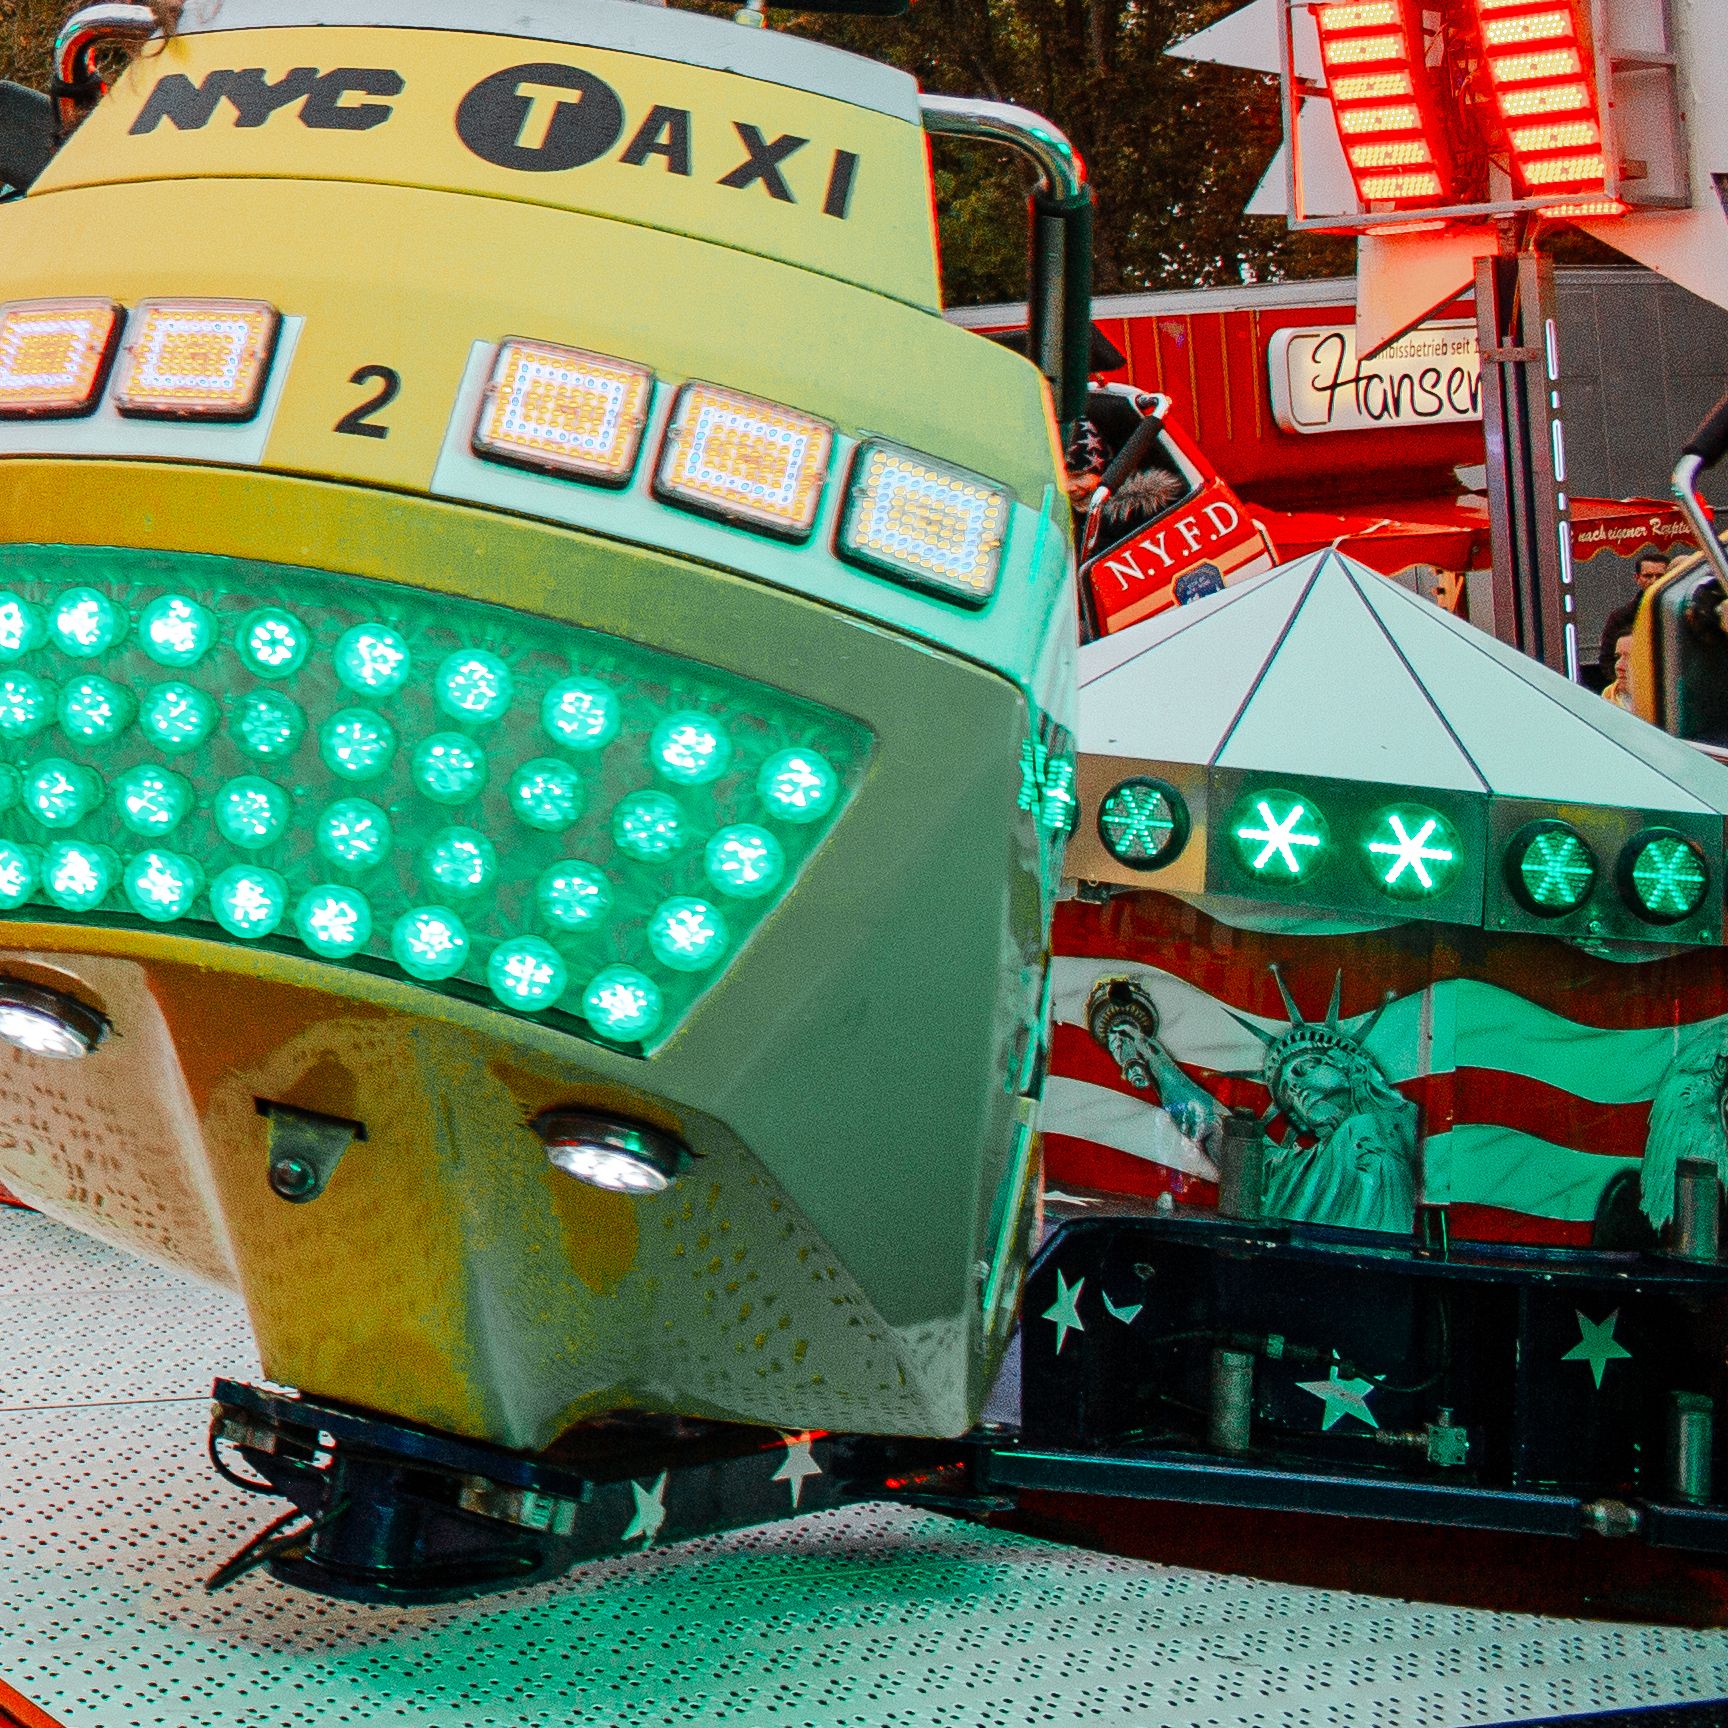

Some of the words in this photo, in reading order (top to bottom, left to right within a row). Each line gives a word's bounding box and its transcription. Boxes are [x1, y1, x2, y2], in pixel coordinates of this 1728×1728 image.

[129, 66, 406, 136] NYC
[458, 62, 860, 221] TAXI
[1451, 340, 1470, 355] seit
[334, 362, 403, 439] 2
[1103, 501, 1239, 592] N.Y.F.D
